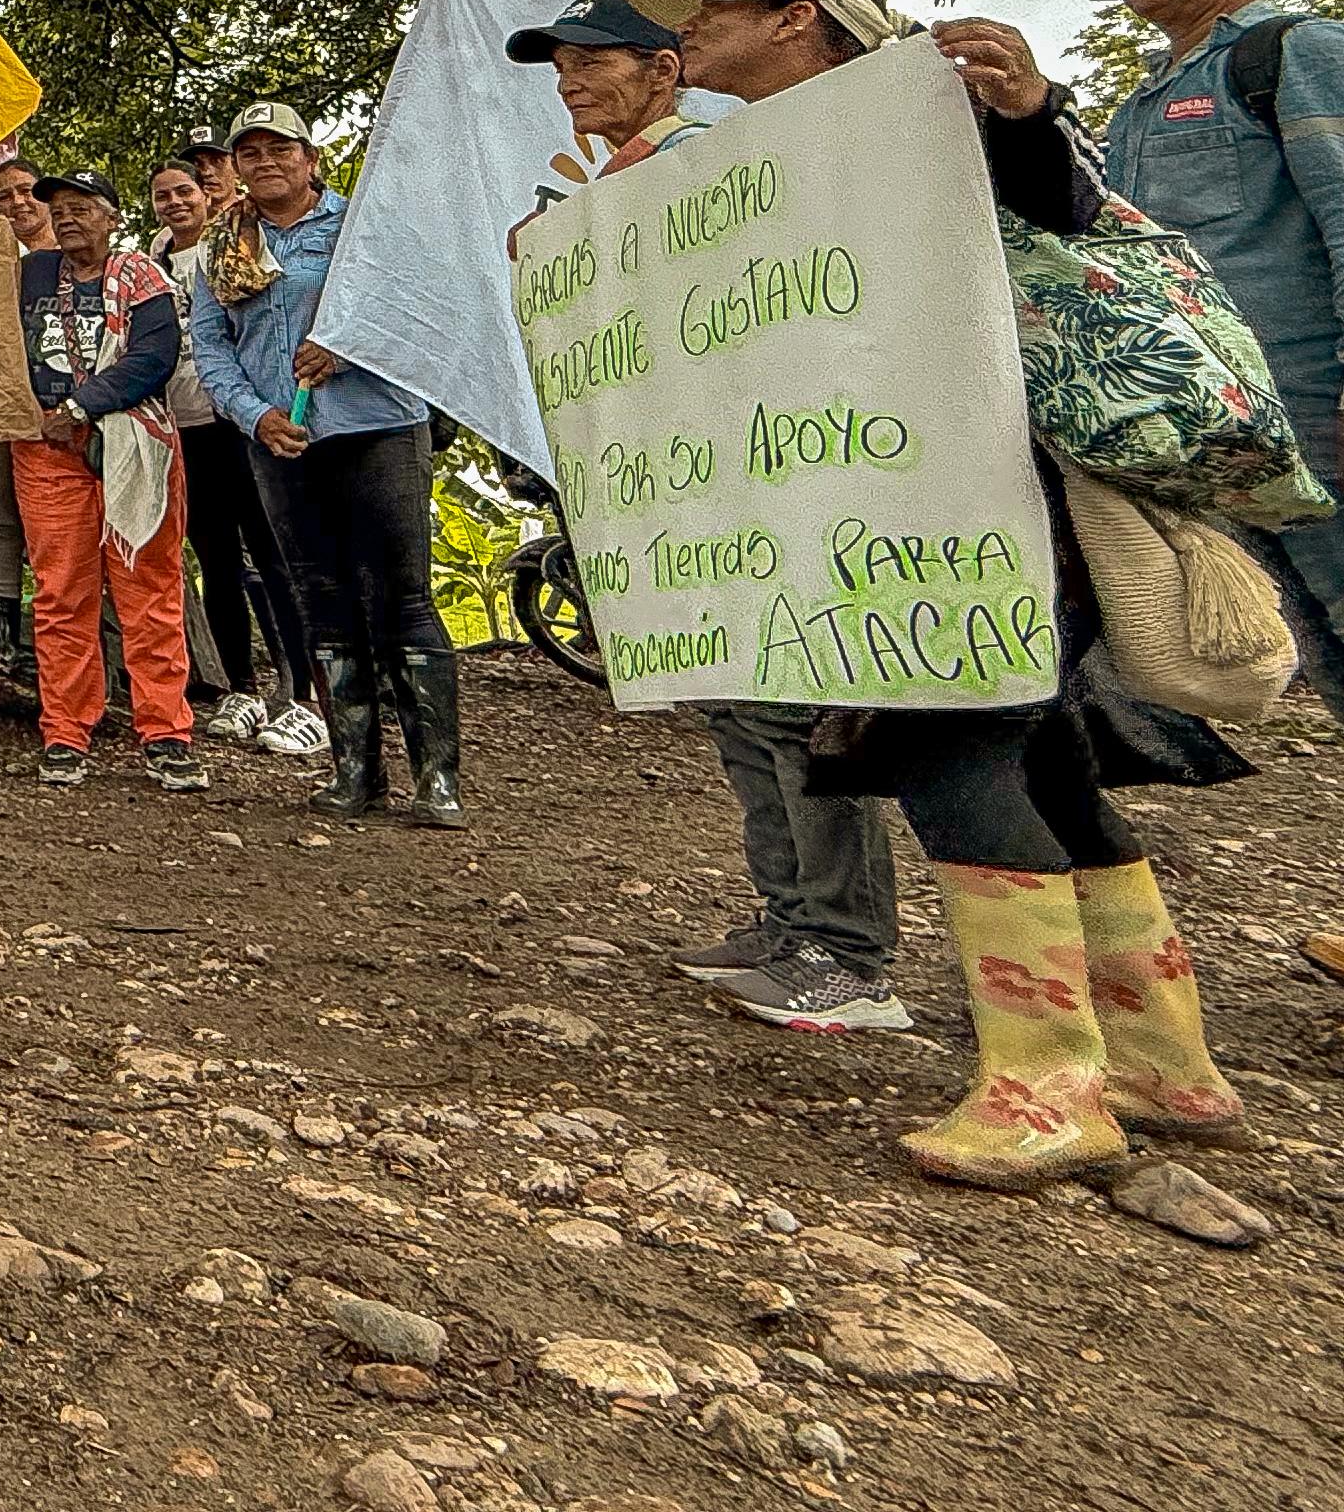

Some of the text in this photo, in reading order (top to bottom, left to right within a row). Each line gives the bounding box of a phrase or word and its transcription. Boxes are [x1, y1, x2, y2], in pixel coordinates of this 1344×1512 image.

[518, 160, 776, 327] GRACIAS A NUESTRO
[680, 247, 859, 356] GUSTAVO
[669, 436, 713, 490] SU
[749, 402, 908, 476] APOYO
[833, 517, 1016, 591] PARRA
[762, 592, 1055, 689] ATACAR
